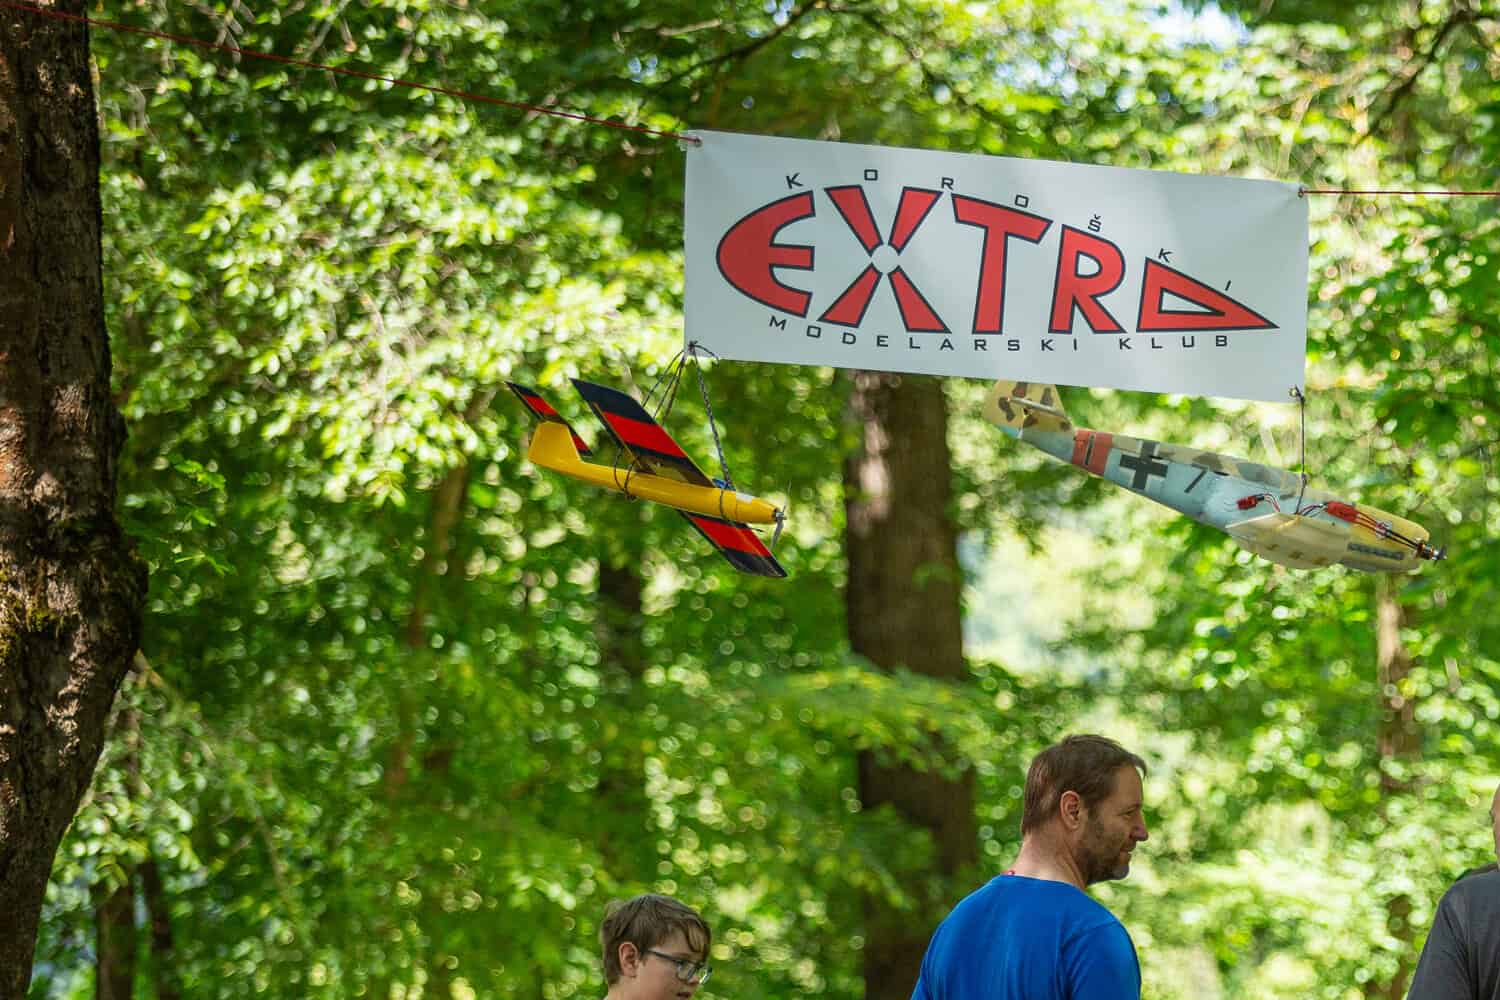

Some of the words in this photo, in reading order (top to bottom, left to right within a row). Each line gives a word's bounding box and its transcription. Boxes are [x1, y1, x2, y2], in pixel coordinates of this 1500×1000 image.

[715, 183, 1280, 335] EXTRA
[786, 168, 1233, 292] KOROŠKI
[768, 316, 1079, 352] MODELARSKI
[1118, 335, 1230, 351] KLUB
